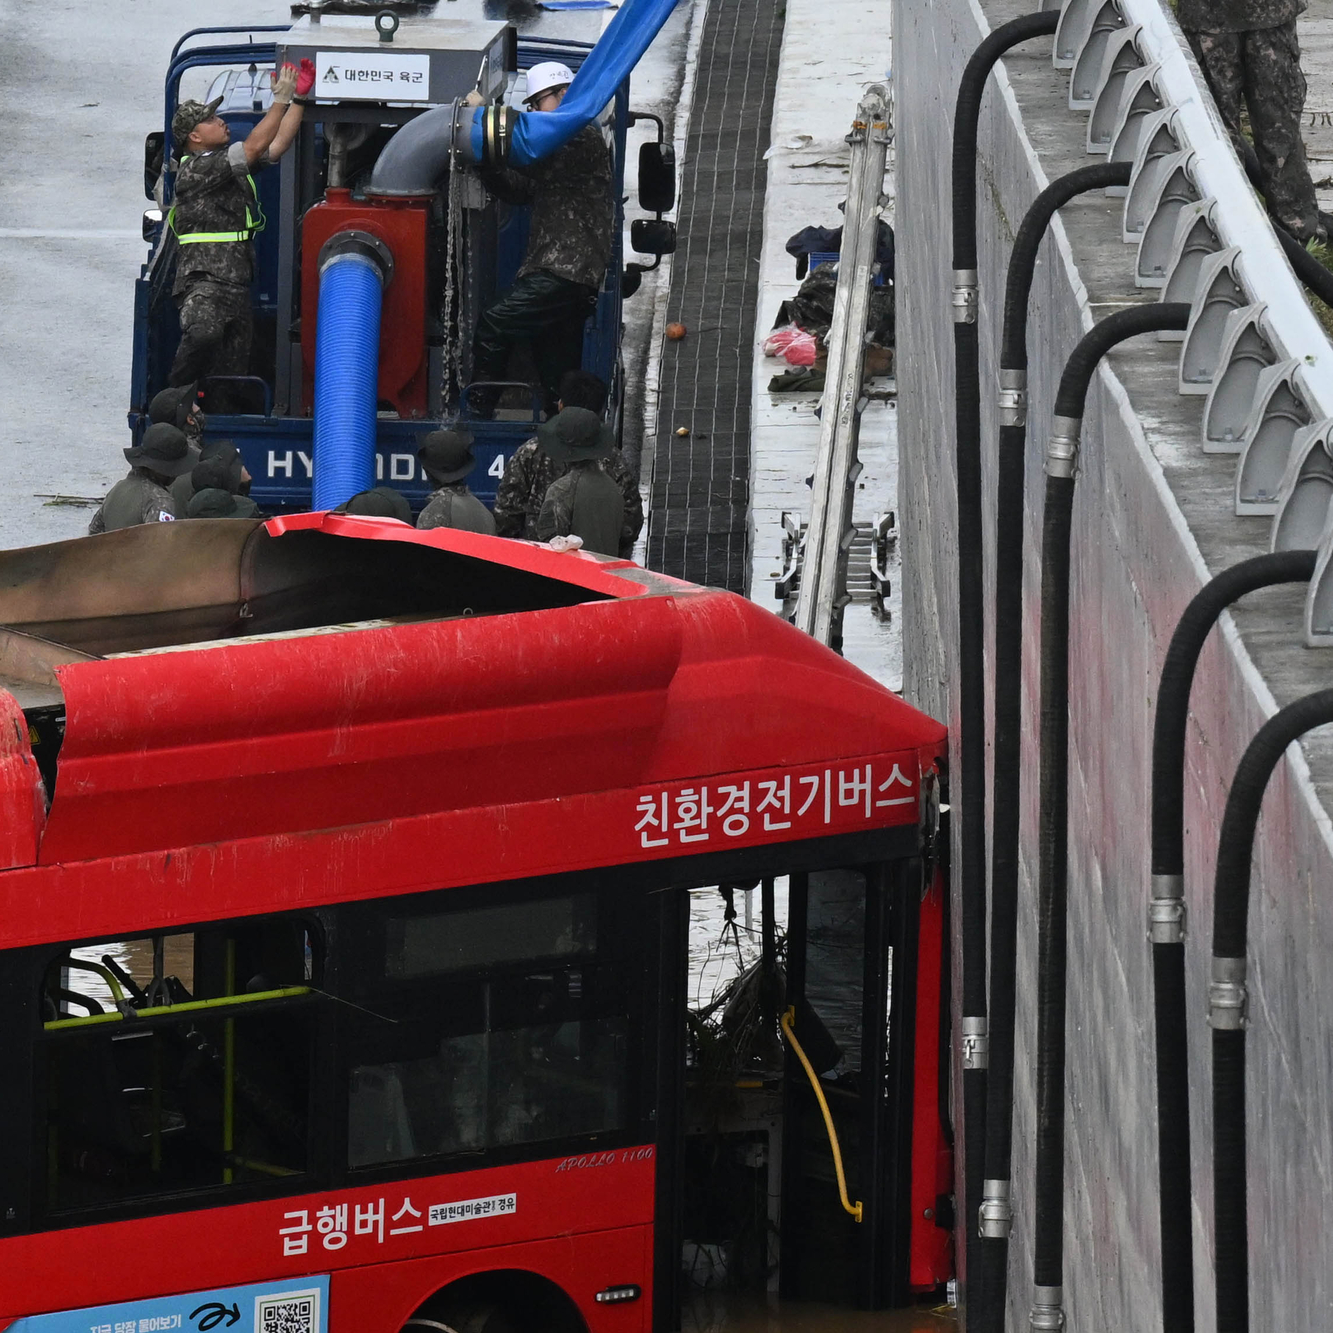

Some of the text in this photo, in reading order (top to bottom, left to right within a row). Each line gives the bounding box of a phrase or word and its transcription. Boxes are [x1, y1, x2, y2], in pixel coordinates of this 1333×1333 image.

[344, 69, 394, 82] 대한민국
[399, 71, 423, 84] 육군
[634, 763, 915, 848] 친환경전기버스
[555, 1147, 653, 1173] APOLLO 1100
[430, 1201, 491, 1221] 국립현대미술관
[498, 1197, 515, 1211] 경유
[278, 1197, 424, 1257] 급행버스
[138, 1314, 182, 1333] 물어보기
